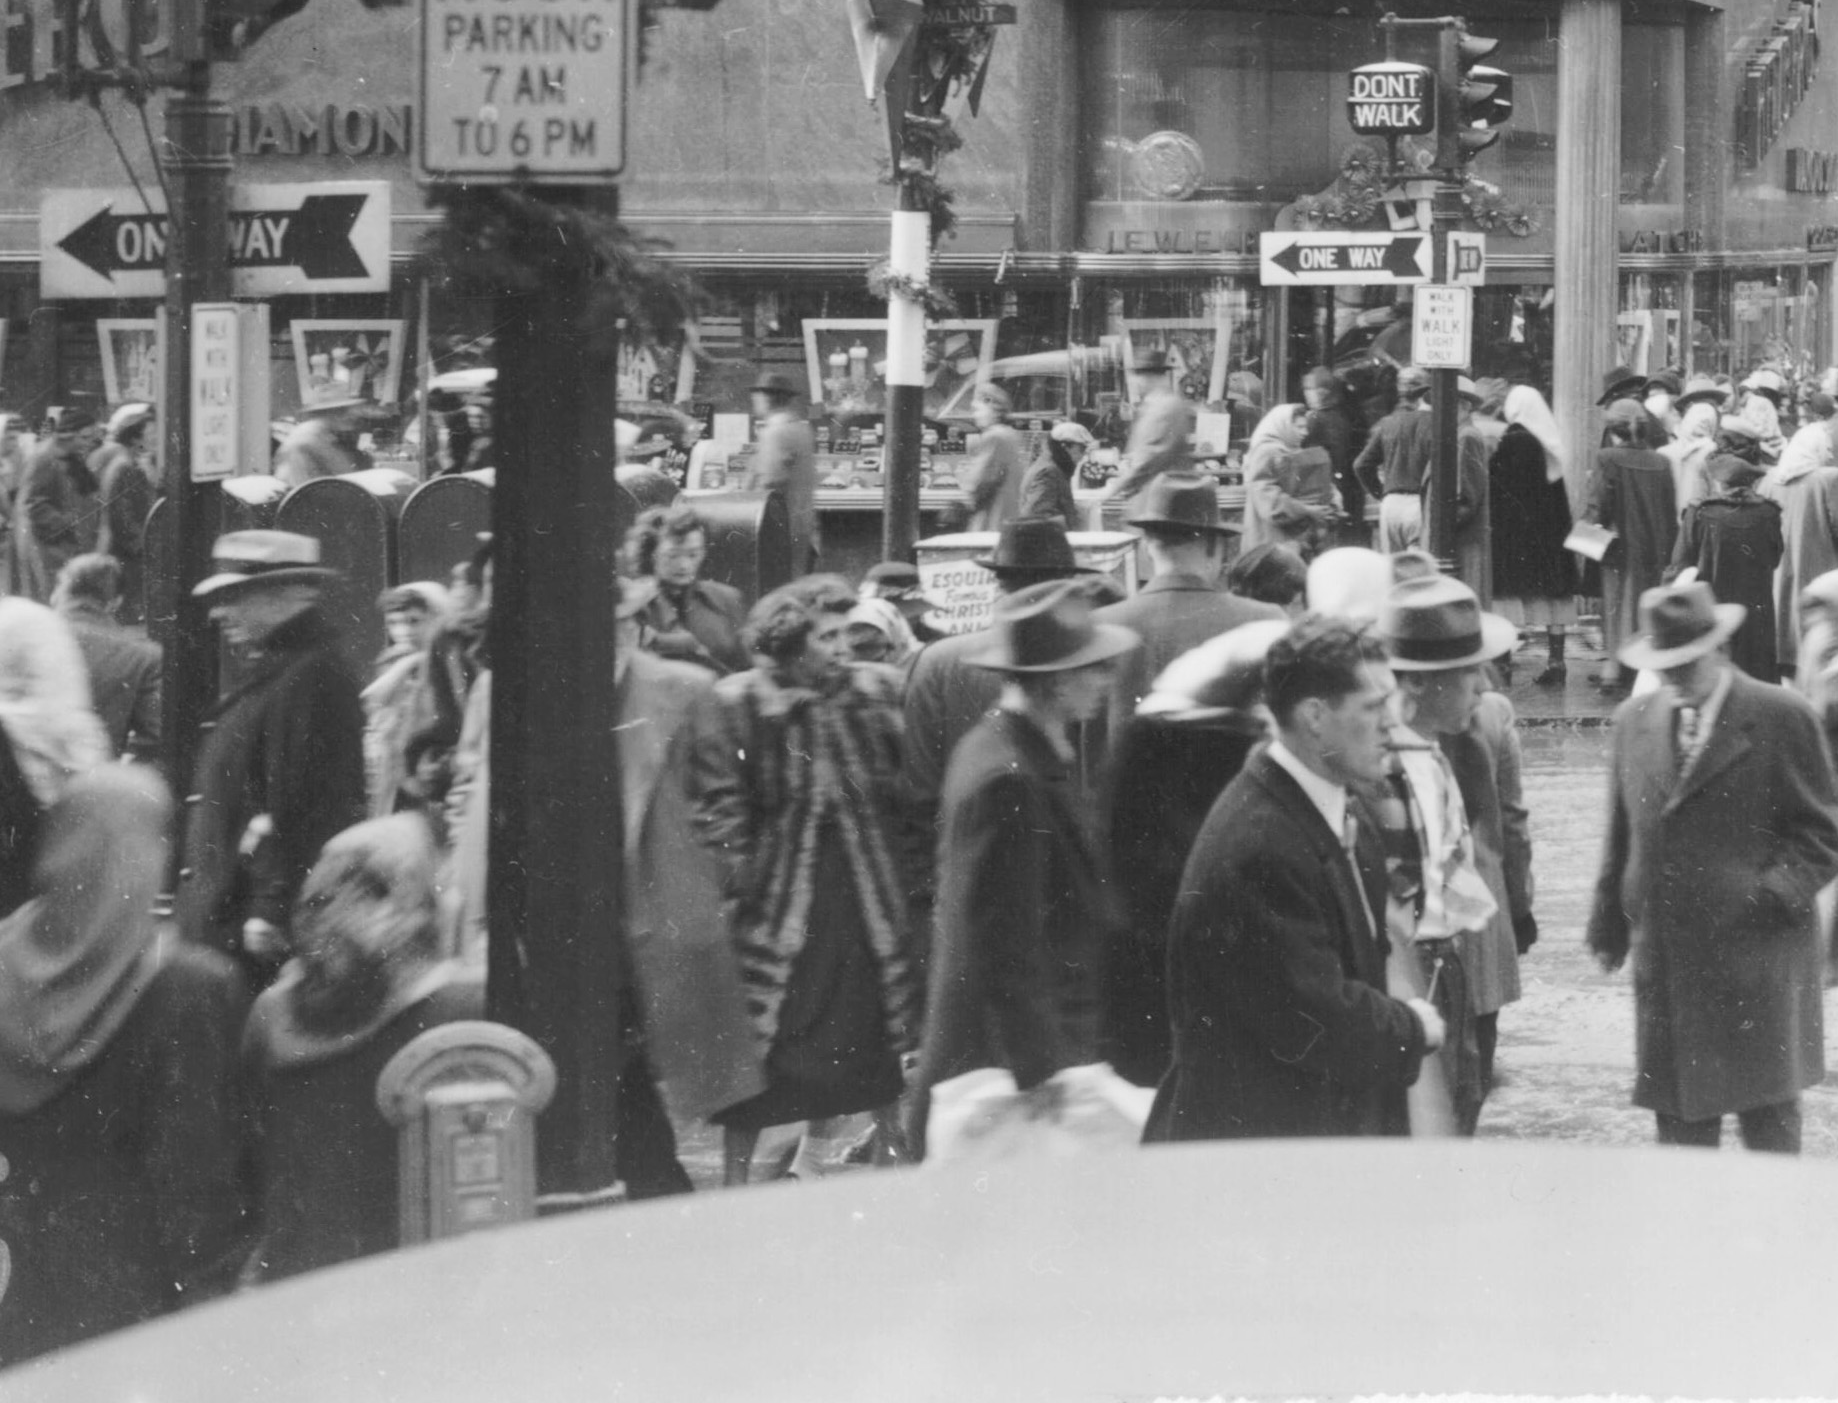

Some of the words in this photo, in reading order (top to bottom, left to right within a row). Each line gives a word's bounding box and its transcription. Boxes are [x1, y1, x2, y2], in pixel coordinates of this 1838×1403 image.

[445, 12, 603, 53] PARKING
[478, 65, 502, 105] 7
[513, 64, 567, 105] AM
[1355, 104, 1421, 127] WALK
[454, 117, 498, 157] TO
[510, 119, 532, 157] 6
[545, 118, 597, 157] PM
[117, 220, 167, 263] ON
[1299, 247, 1339, 270] ONE
[1347, 246, 1387, 269] WAY
[1421, 318, 1460, 334] WALK
